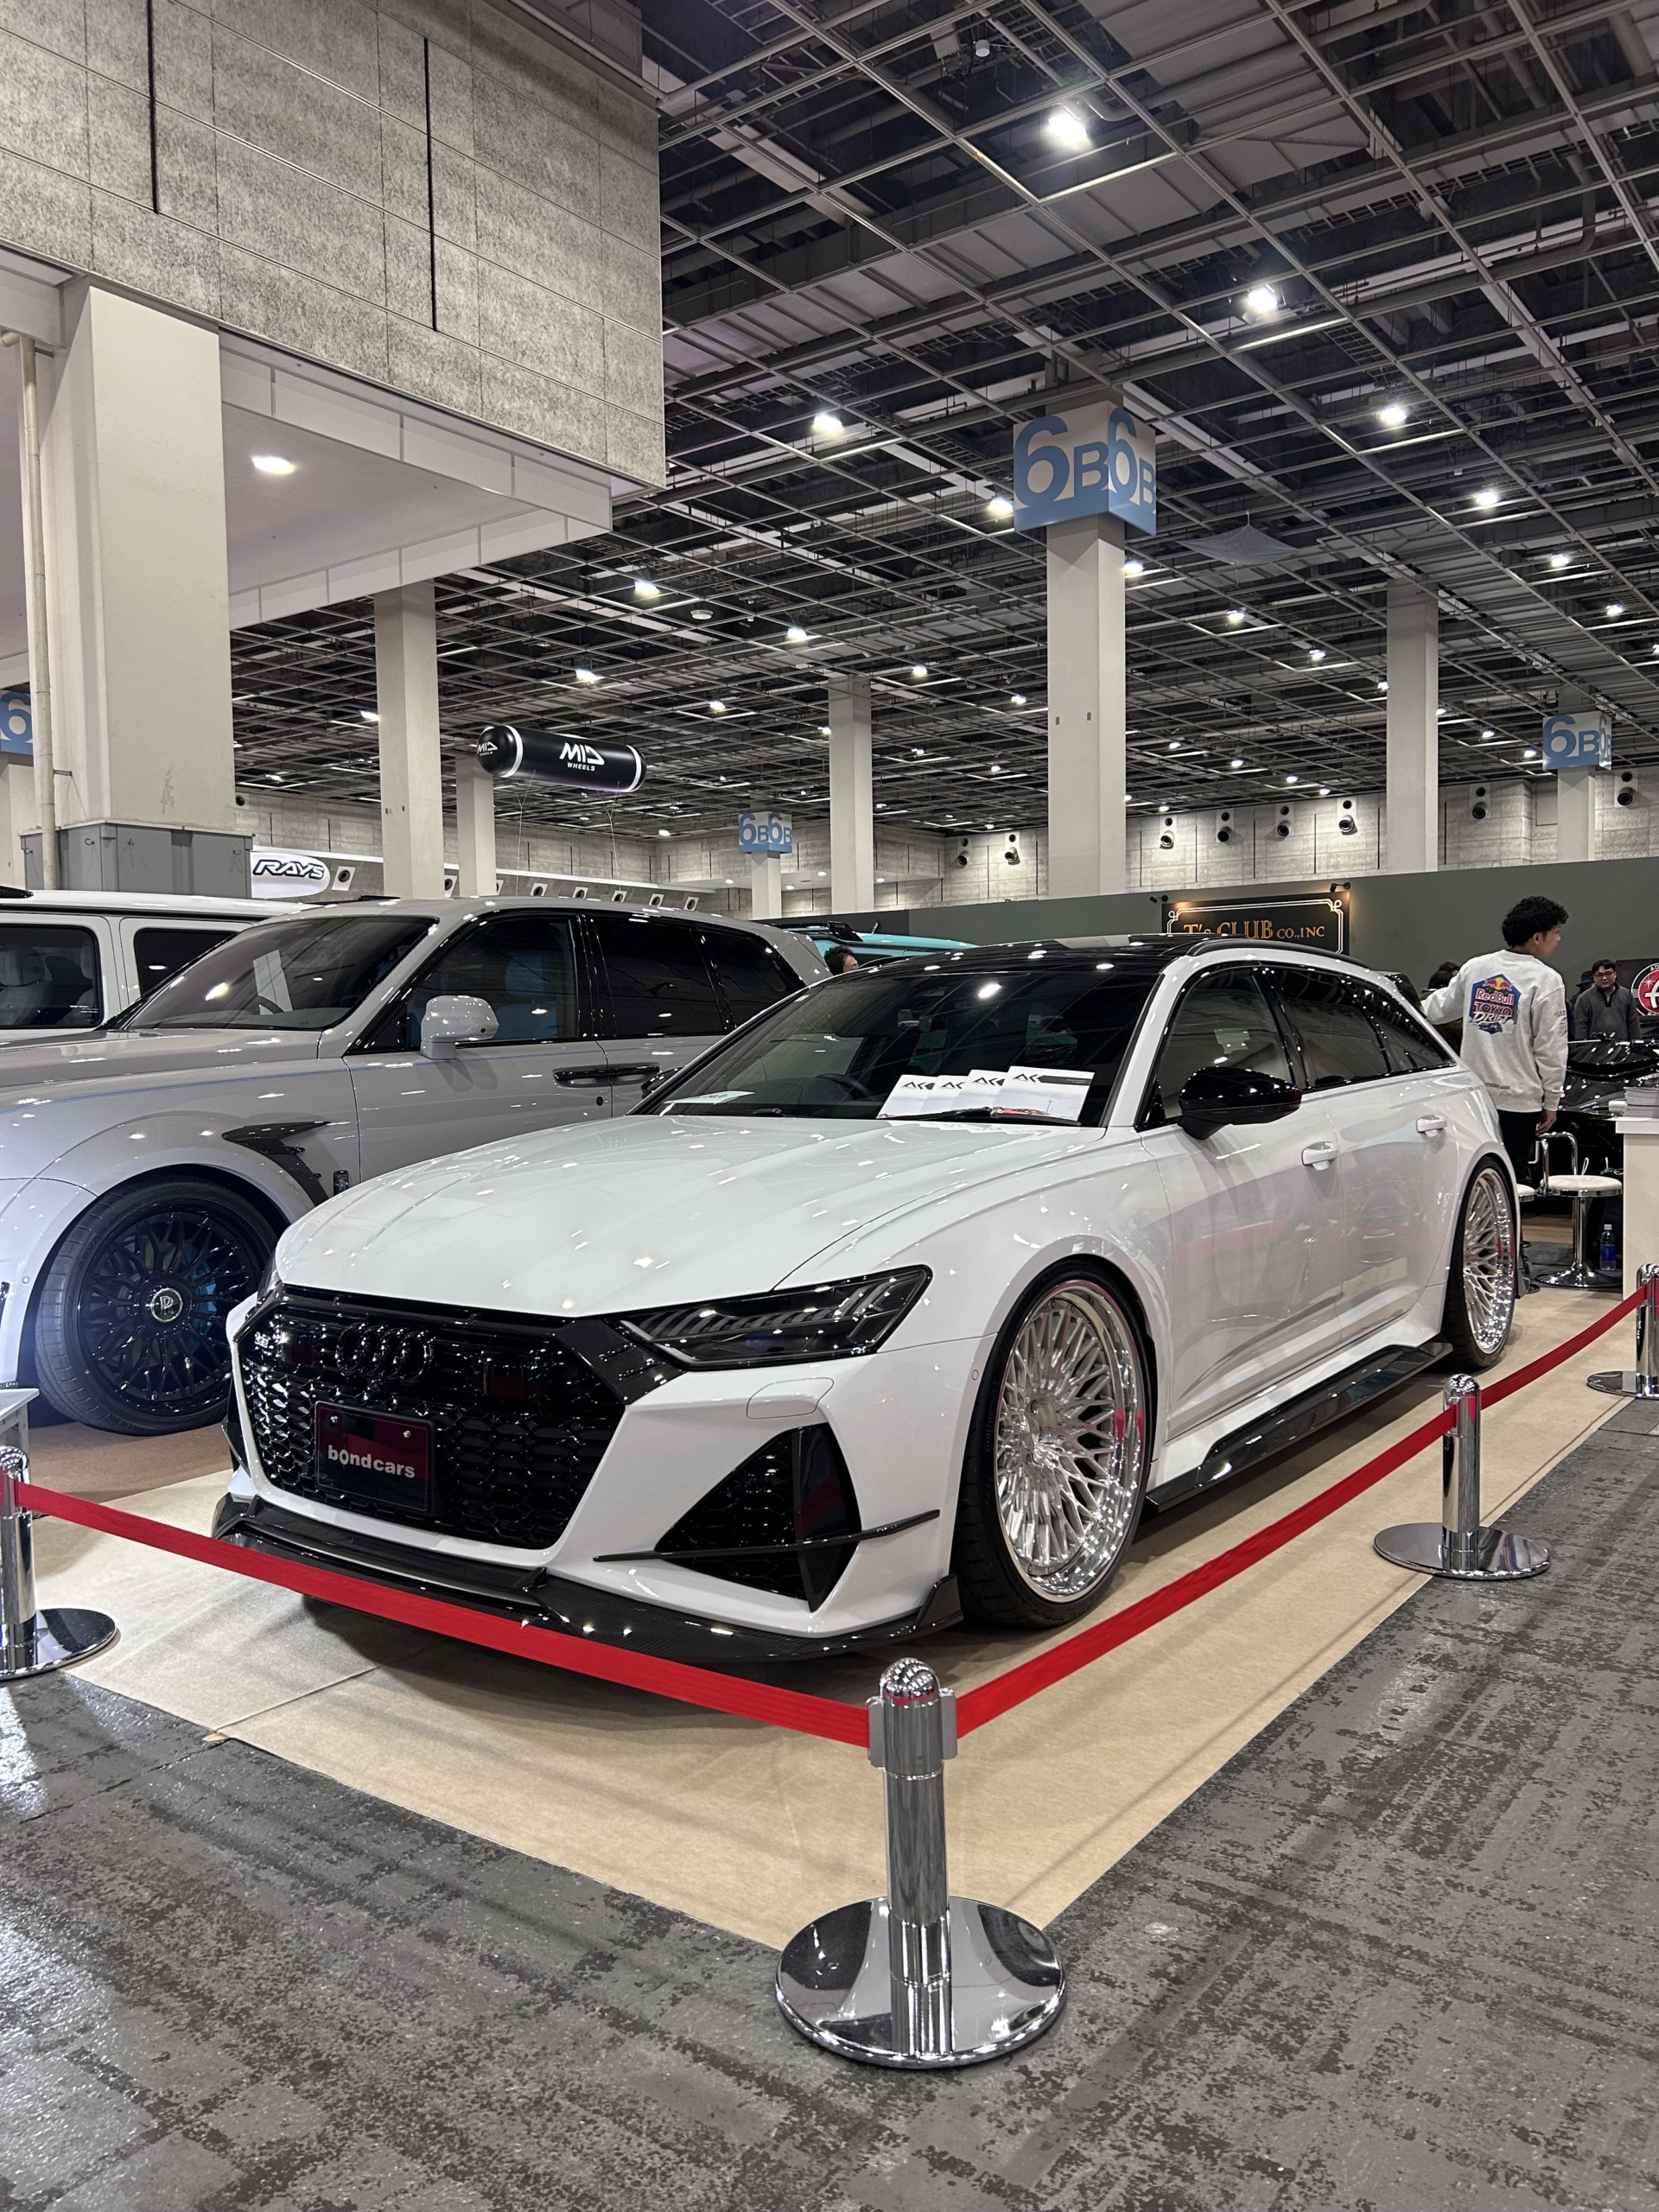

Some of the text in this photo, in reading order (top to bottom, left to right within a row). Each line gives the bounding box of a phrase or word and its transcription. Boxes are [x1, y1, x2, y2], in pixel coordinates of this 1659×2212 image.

[1014, 416, 1109, 508] 6B
[1109, 408, 1156, 512] 6B
[1543, 715, 1599, 760] 6B
[567, 762, 595, 772] WHEELS
[739, 813, 769, 846] 6B
[768, 812, 792, 846] 6B
[252, 859, 325, 880] RAYS
[1472, 1011, 1512, 1024] DRIFT
[1474, 1001, 1513, 1016] TOKYO
